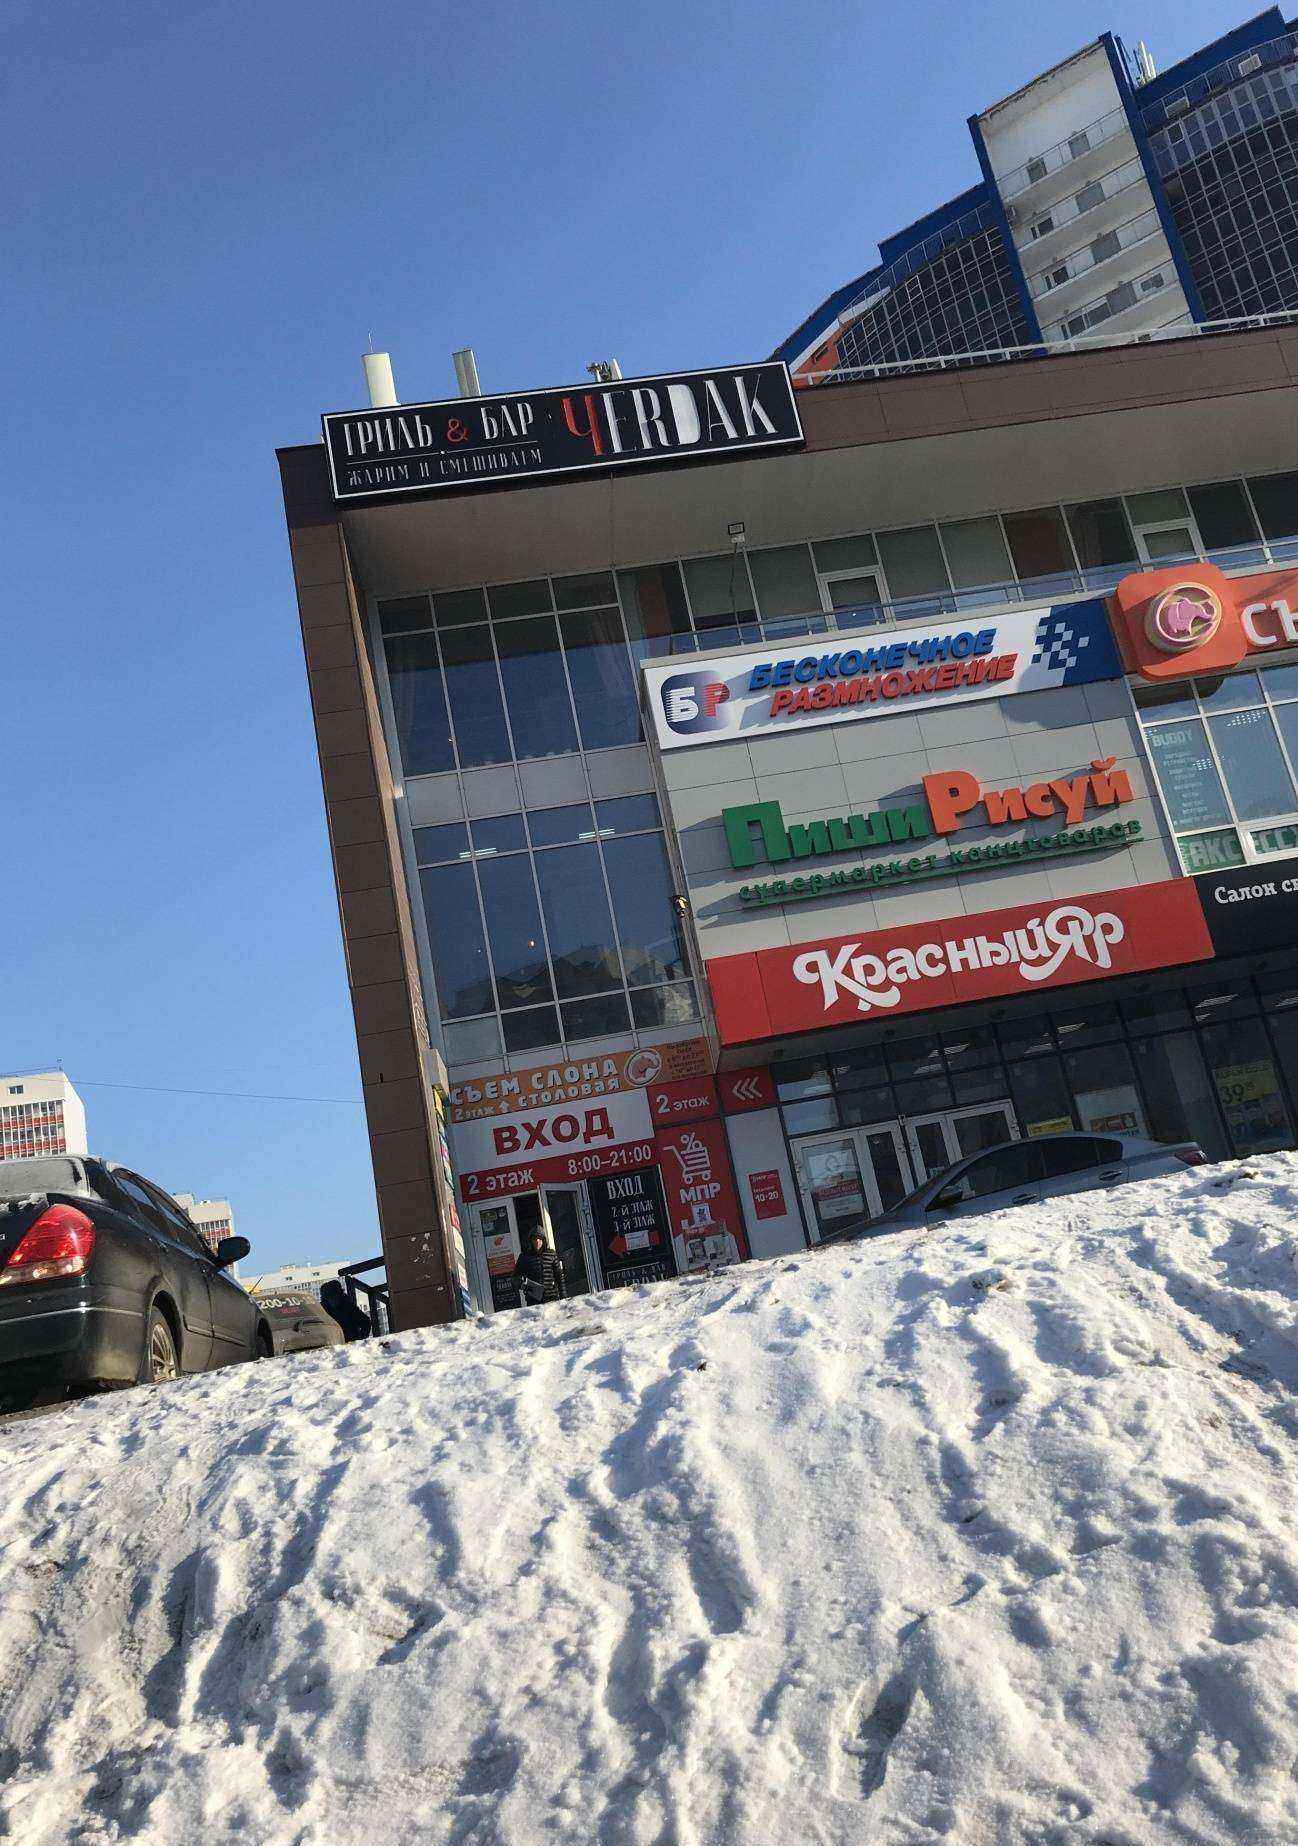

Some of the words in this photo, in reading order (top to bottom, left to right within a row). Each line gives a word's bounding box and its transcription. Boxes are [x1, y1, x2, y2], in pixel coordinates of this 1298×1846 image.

[343, 415, 433, 456] ГРИЛЬ
[446, 418, 471, 443] &
[480, 402, 534, 440] БАР
[348, 464, 409, 486] ЖАРИМ
[419, 462, 430, 478] И
[747, 628, 997, 692] БЕСКОНЕЧНОЕ
[664, 681, 731, 724] БР
[769, 652, 1019, 718] РАЗМНОЖЕНИЕ
[739, 854, 937, 904] супермаркет
[1214, 876, 1278, 904] Салон
[450, 1076, 521, 1106] СЪЕМ
[531, 1059, 618, 1090] СЛОНА
[655, 1094, 671, 1114] 2
[673, 1096, 710, 1111] этаж
[492, 1107, 615, 1156] ВХОД
[467, 1175, 480, 1195] 2
[485, 1168, 535, 1191] этаж
[606, 1175, 644, 1200] ВХОД
[680, 1182, 720, 1204] МПР
